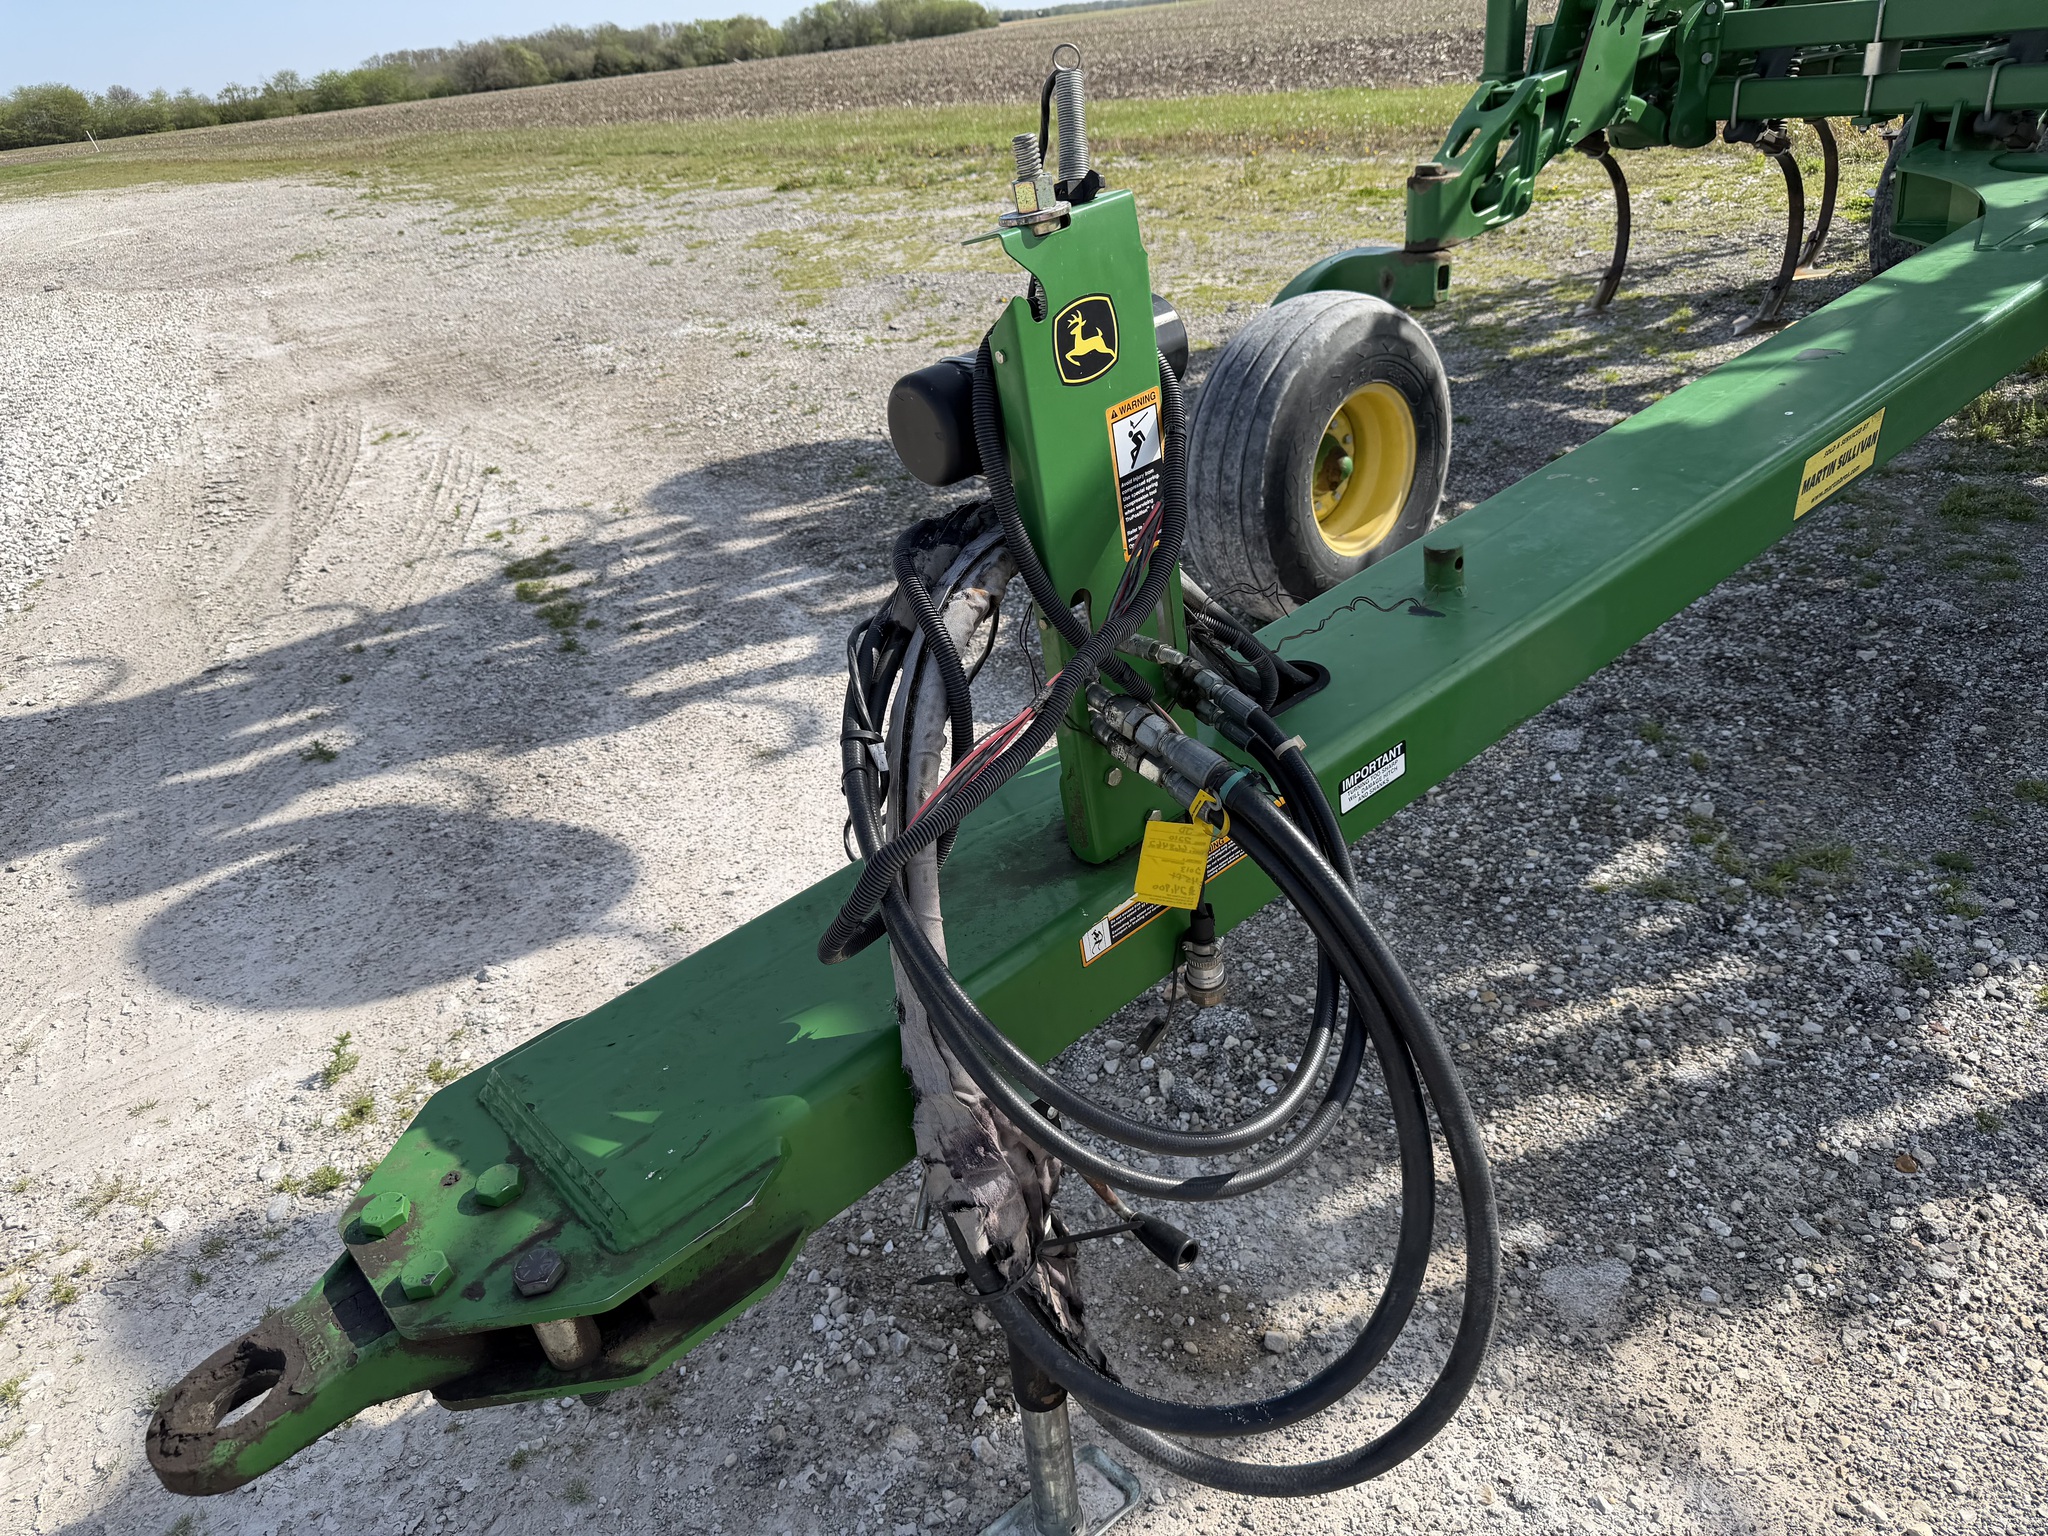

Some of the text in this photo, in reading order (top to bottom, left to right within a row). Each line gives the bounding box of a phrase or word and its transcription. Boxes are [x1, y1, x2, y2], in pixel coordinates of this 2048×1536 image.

[1119, 391, 1156, 415] WARNING
[1801, 429, 1880, 496] MARTIN SULLIVAN
[1342, 742, 1403, 792] IMPORTANT
[1347, 759, 1399, 797] TURNING TOO SHARP
[1347, 790, 1360, 802] WILL
[1361, 776, 1383, 794] DAMAGE
[1357, 778, 1390, 802] AND SHANKS
